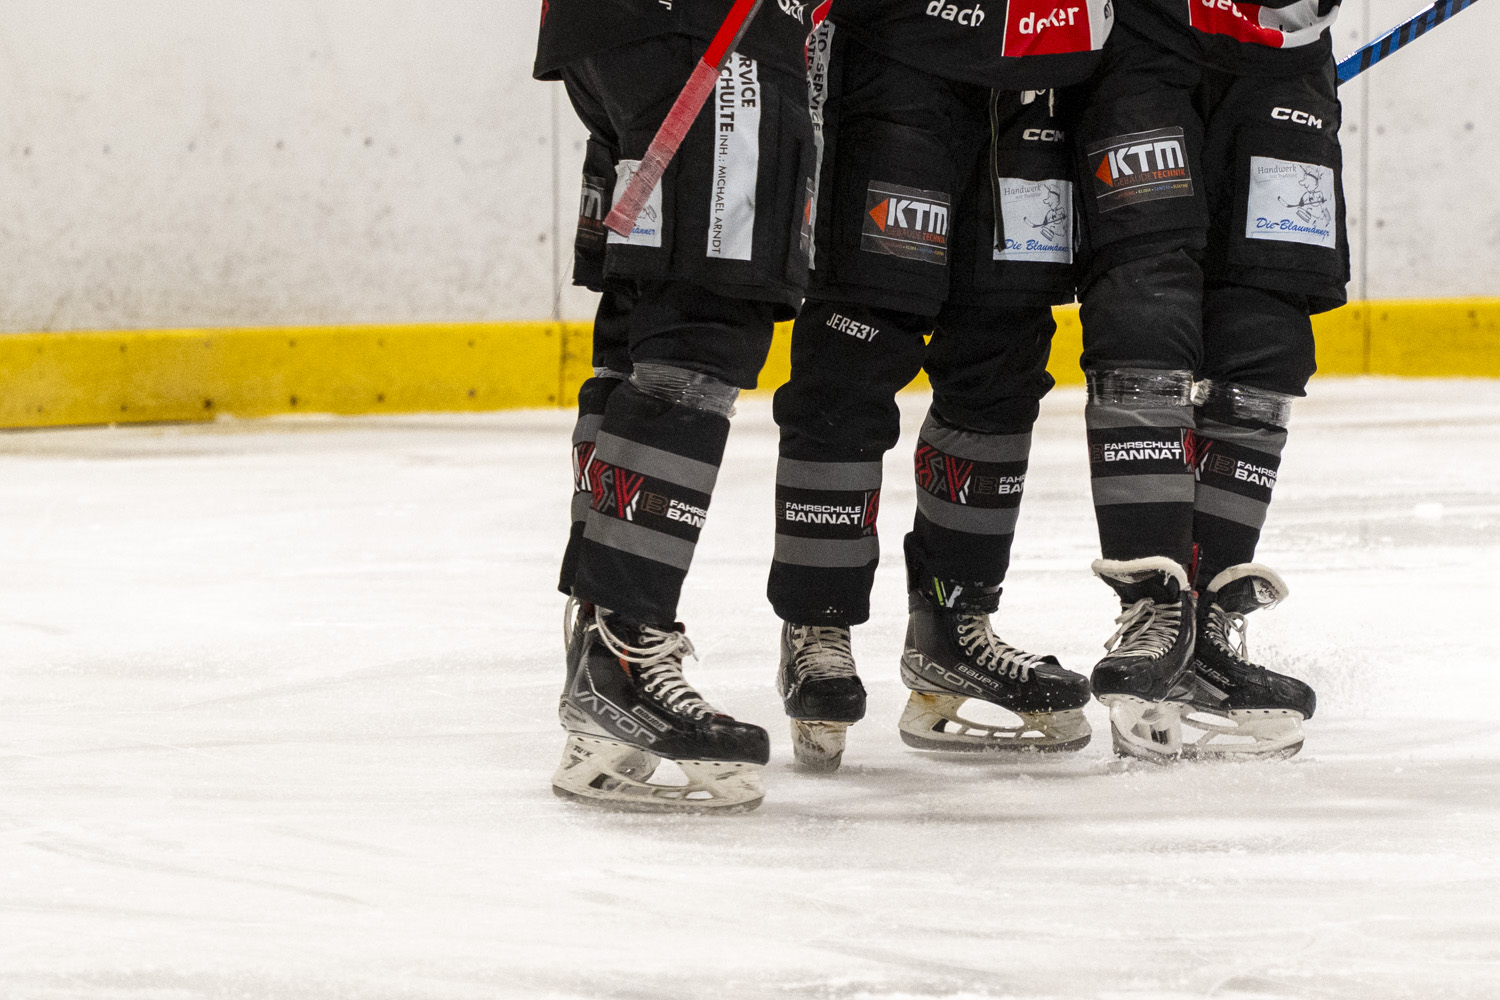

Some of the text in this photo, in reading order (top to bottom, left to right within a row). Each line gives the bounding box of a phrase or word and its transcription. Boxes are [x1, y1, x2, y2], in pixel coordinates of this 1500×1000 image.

[1270, 105, 1324, 130] CCM
[1022, 128, 1065, 143] CCM
[1107, 140, 1185, 180] KTM
[1152, 168, 1186, 180] TECHNIK
[1257, 165, 1298, 175] Handwerk
[714, 165, 727, 214] MICHAEL
[887, 197, 948, 236] KTM
[1256, 217, 1276, 230] Die
[711, 216, 724, 255] ARNDT
[1005, 238, 1022, 250] Die
[1104, 440, 1181, 451] FAHRSCHULE
[1103, 449, 1182, 462] BANNAT
[785, 501, 862, 514] FAHRSCHULE
[785, 511, 862, 525] BANNAT
